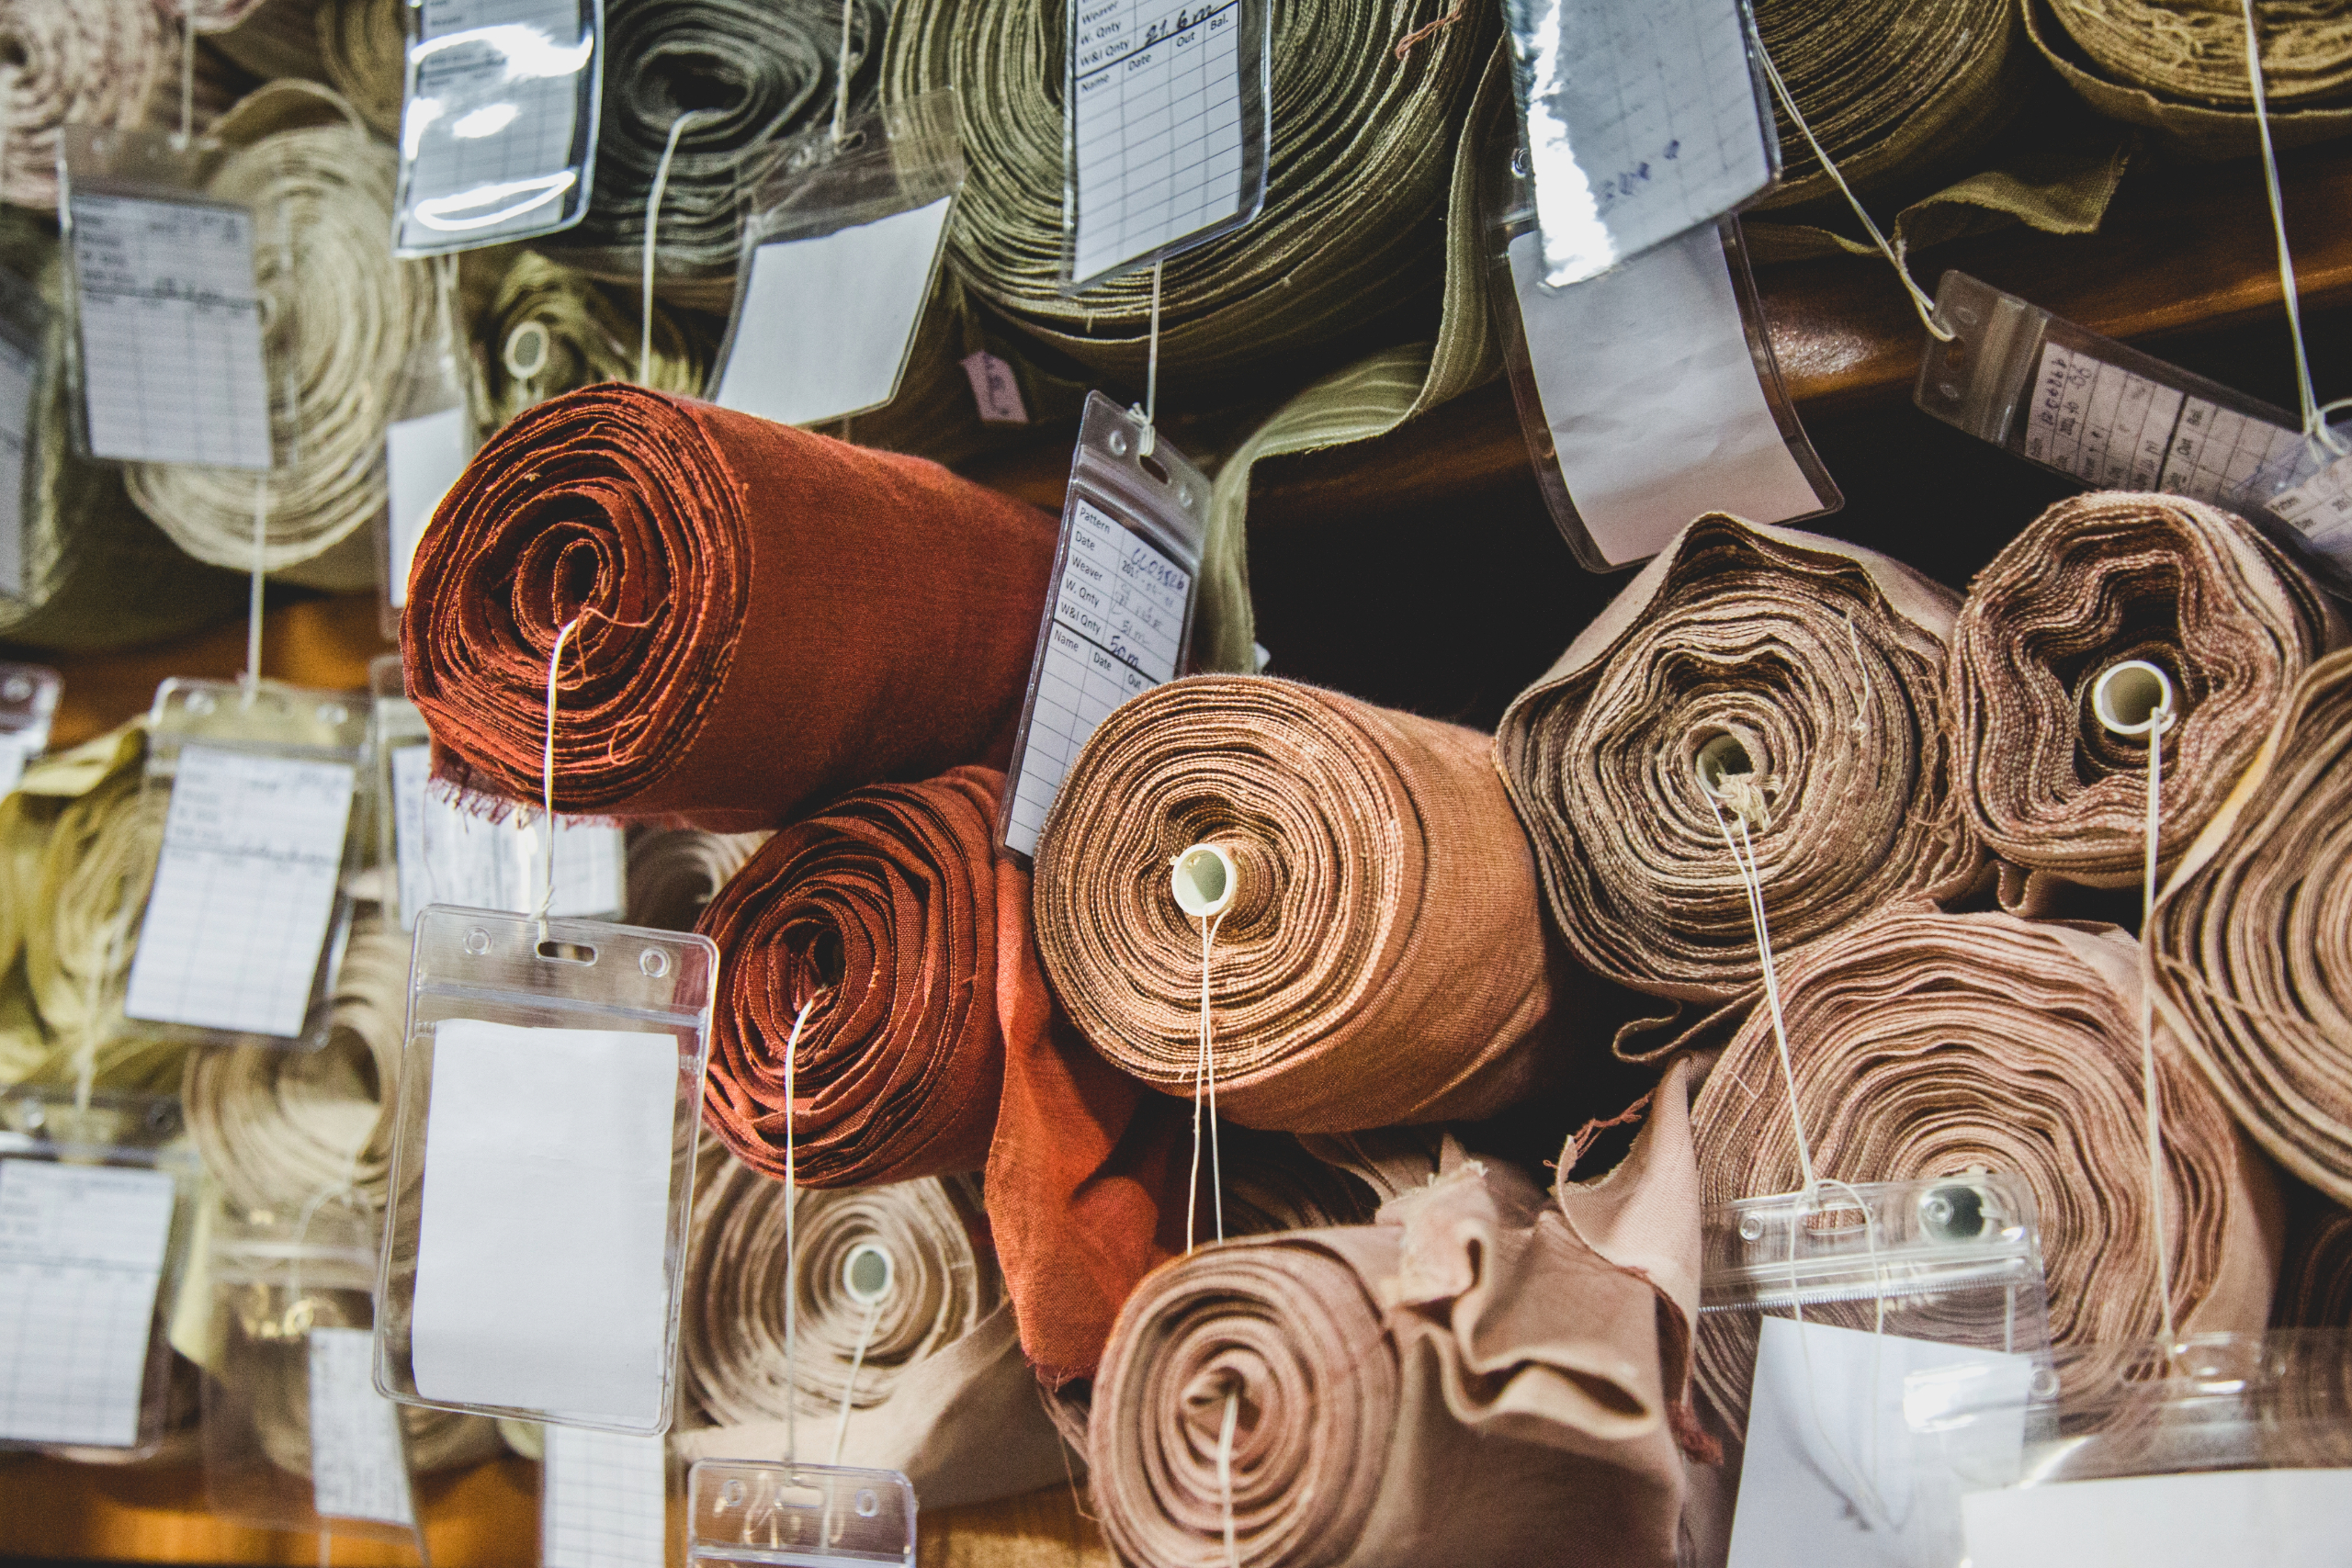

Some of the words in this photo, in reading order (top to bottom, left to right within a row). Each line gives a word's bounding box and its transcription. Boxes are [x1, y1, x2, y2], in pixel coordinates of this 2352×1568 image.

[1081, 0, 1118, 25] Weaver
[1096, 21, 1121, 39] Qnty
[1081, 73, 1110, 93] Name
[1128, 53, 1152, 72] Date
[1176, 31, 1195, 48] Out
[1210, 14, 1229, 30] Bal.
[1105, 39, 1130, 57] Qnty
[1079, 507, 1111, 535] Pattern
[1075, 530, 1096, 551] Date
[1071, 555, 1103, 582] Weaver
[1066, 578, 1077, 594] W.
[1079, 587, 1100, 608] Qnty
[1080, 615, 1102, 636] Qnty
[1054, 629, 1080, 652] Name
[1093, 652, 1112, 671] Date
[1128, 673, 1142, 689] Out
